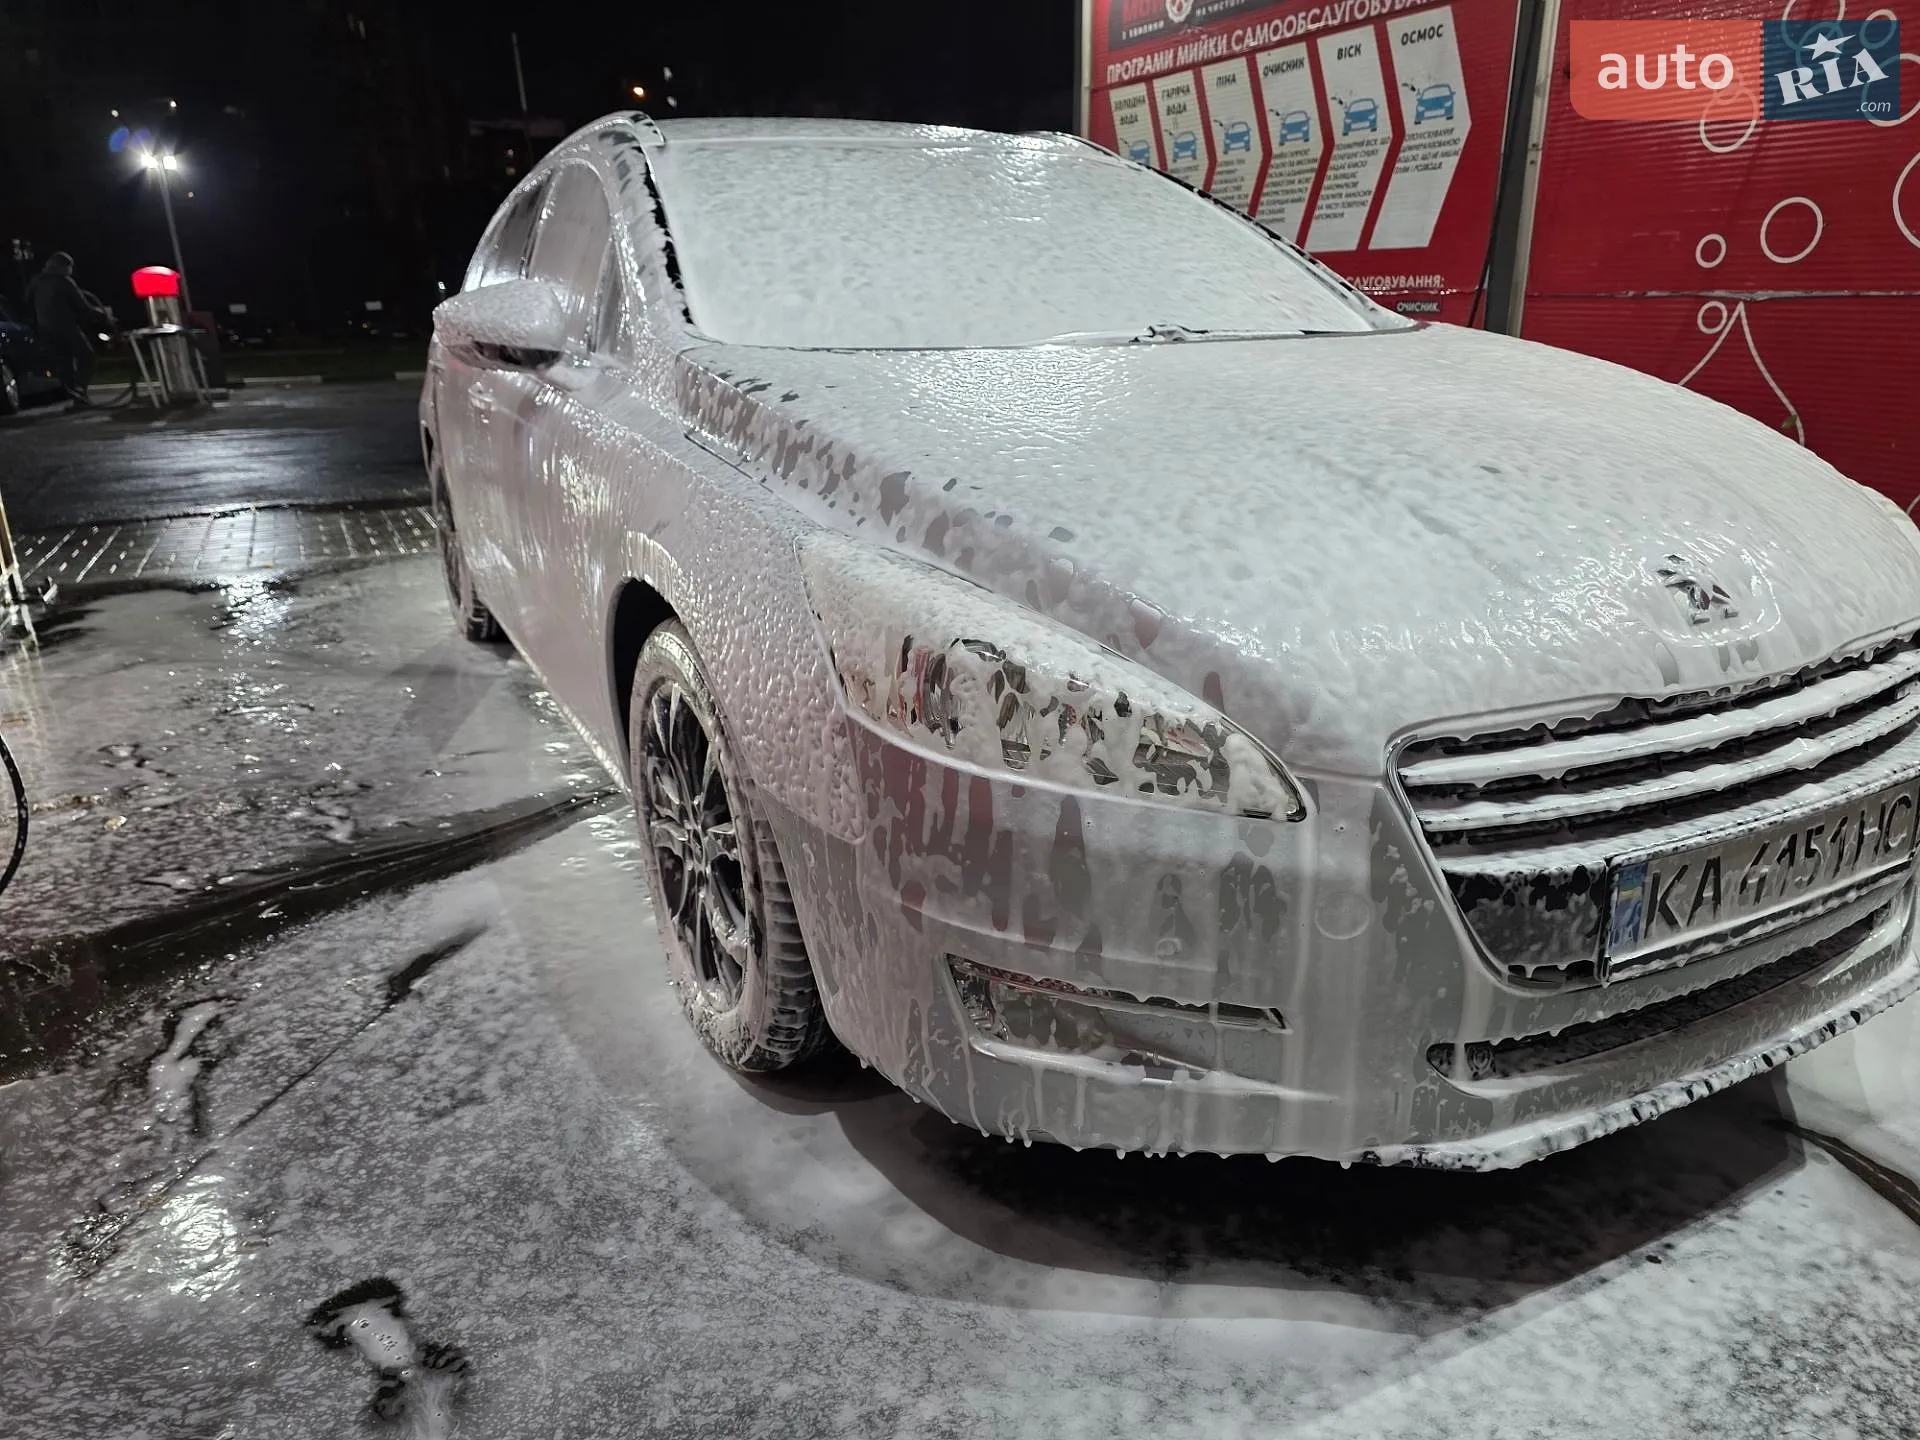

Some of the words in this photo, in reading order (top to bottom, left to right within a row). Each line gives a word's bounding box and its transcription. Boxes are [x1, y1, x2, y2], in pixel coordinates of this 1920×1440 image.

[1401, 24, 1445, 46] ОСМОС
[1107, 48, 1174, 84] ПРОГРАМИ
[1176, 34, 1228, 67] МИЙКИ
[1337, 44, 1362, 60] ВІСК
[1263, 57, 1305, 77] ОЧИСНИК
[1643, 855, 1722, 939] KA
[1739, 815, 1849, 905] 4151
[1852, 793, 1913, 872] HC
